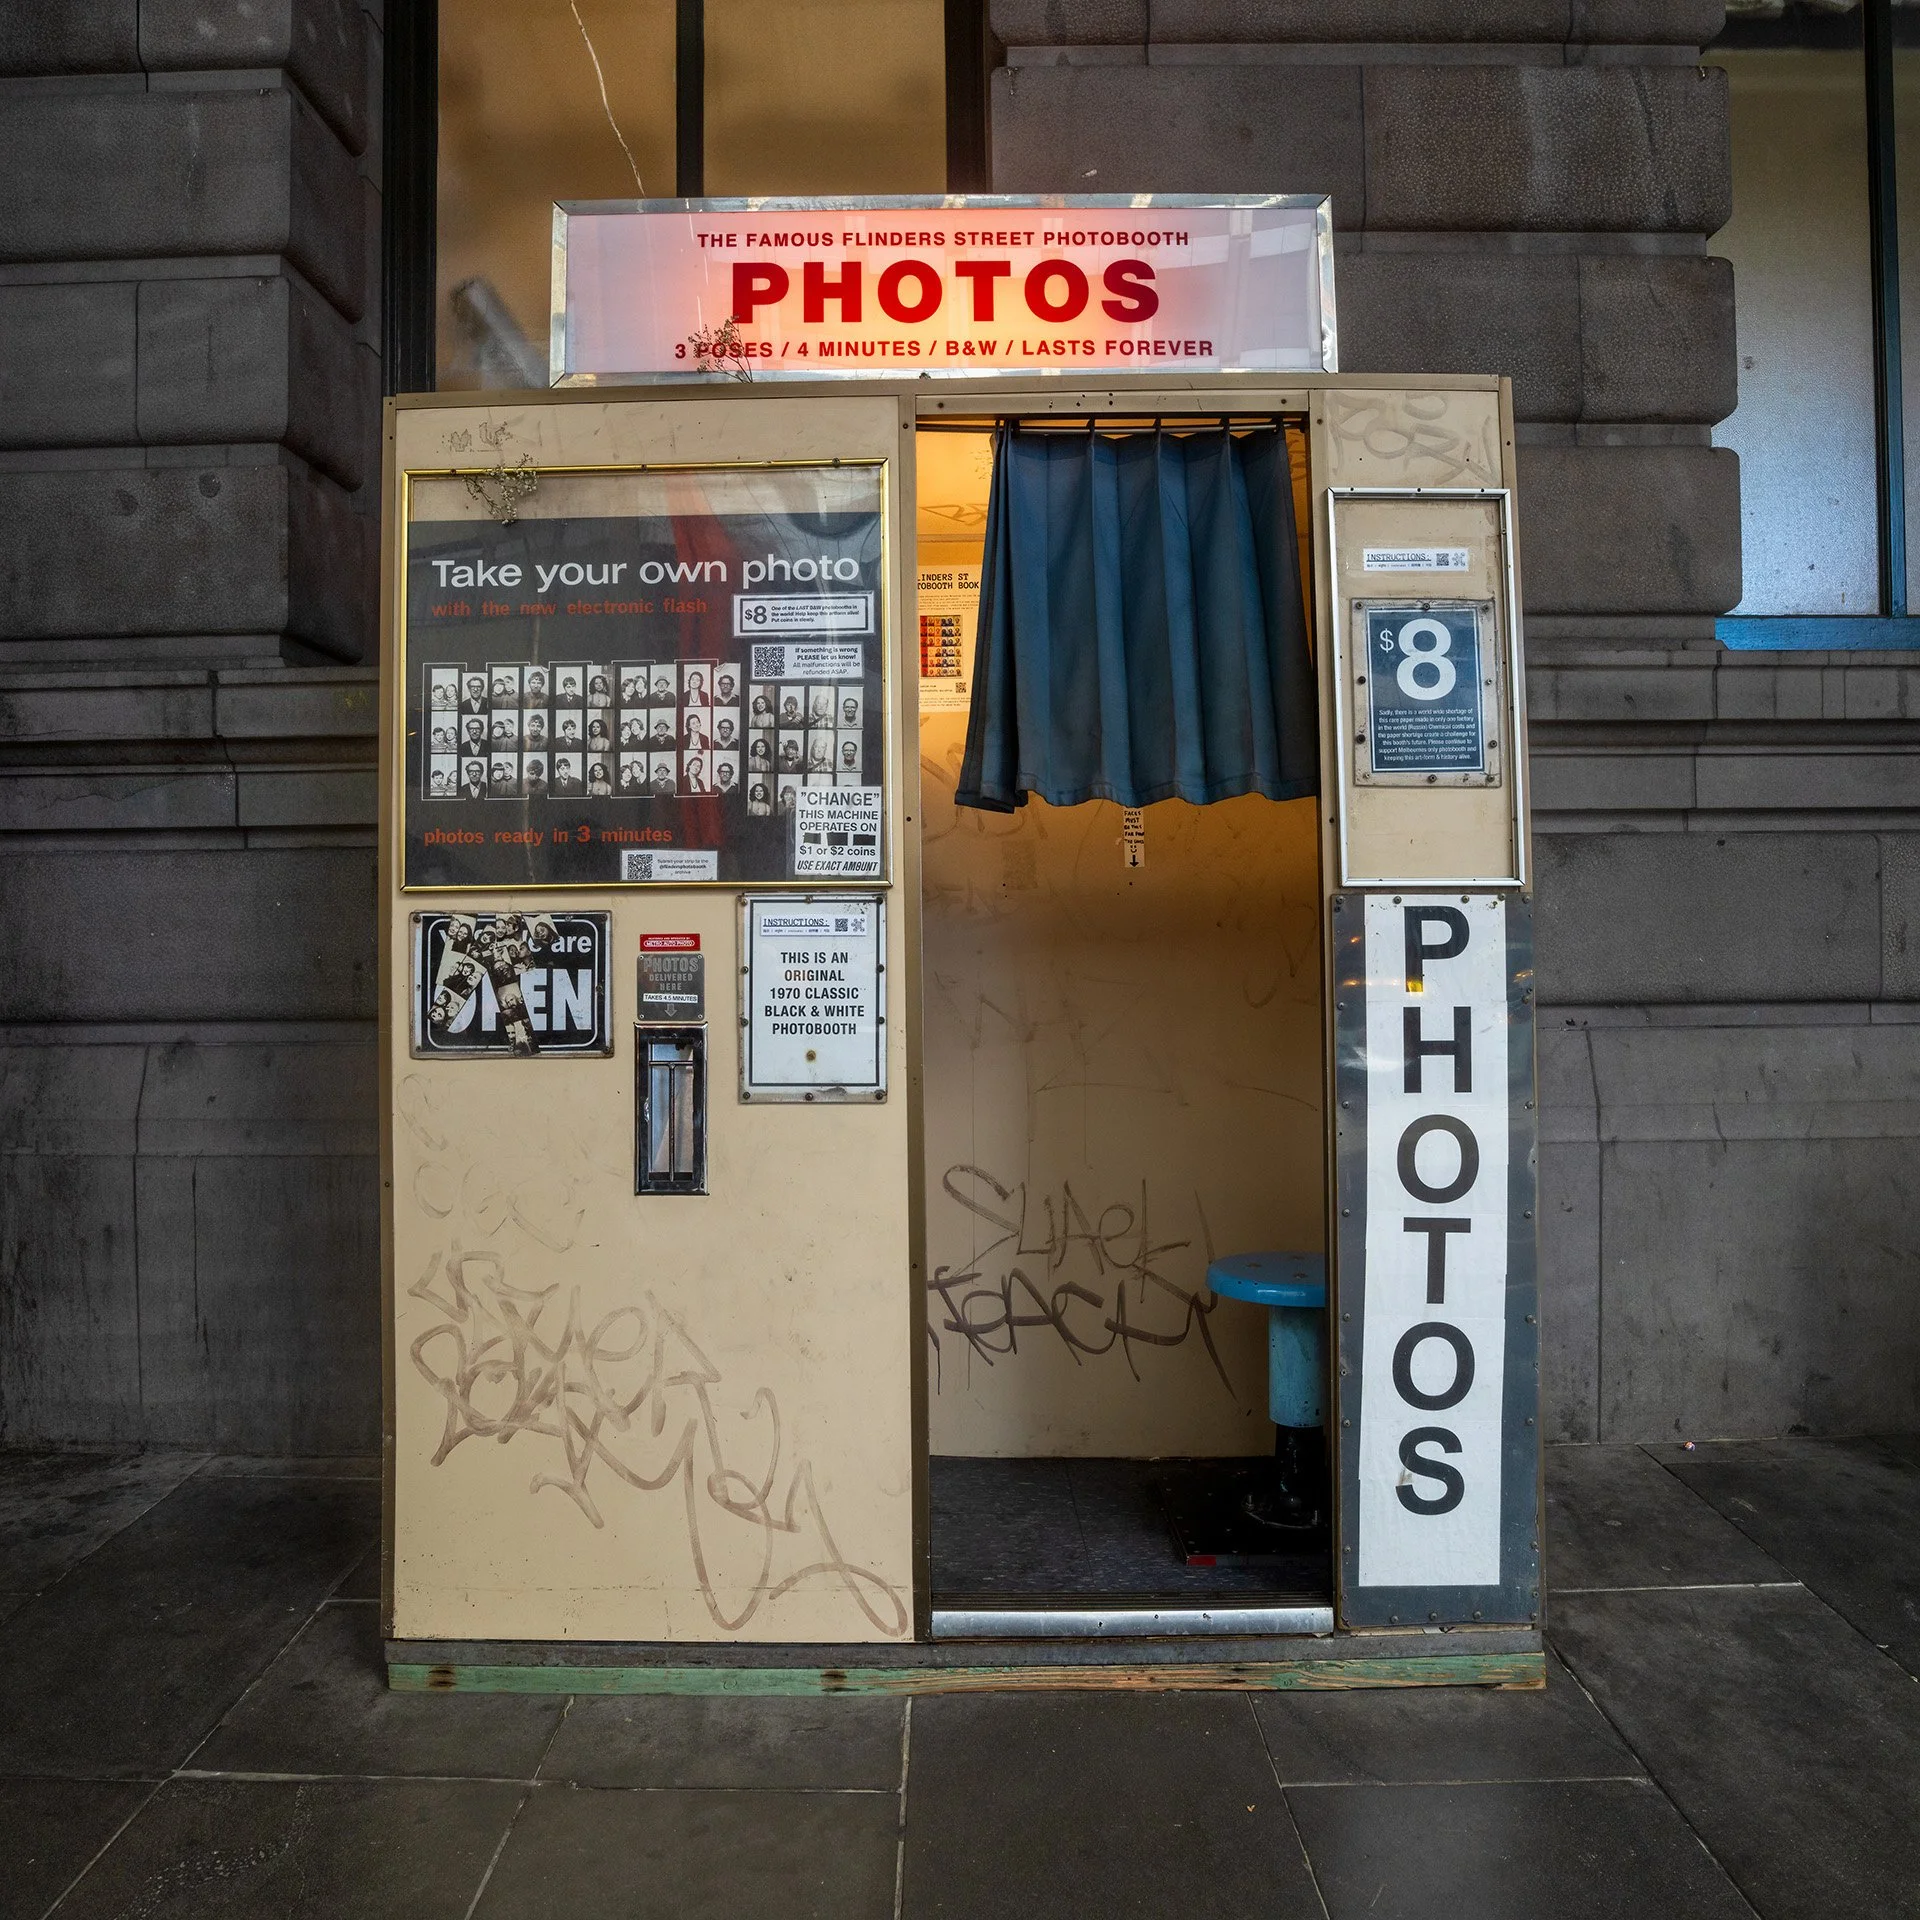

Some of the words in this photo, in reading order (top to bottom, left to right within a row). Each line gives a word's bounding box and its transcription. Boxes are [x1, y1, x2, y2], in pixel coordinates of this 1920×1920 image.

[698, 234, 738, 248] THE
[746, 232, 834, 247] FAMOUS
[842, 232, 946, 246] FLINDERS
[954, 232, 1034, 246] STREET
[1044, 232, 1189, 246] PHOTOBOOTH
[732, 259, 1160, 324] PHOTOS
[675, 344, 686, 358] 3
[697, 342, 773, 358] POSES
[798, 342, 809, 357] 4
[819, 340, 920, 356] MINUTES
[946, 340, 998, 356] B&W
[1022, 340, 1096, 356] LASTS
[1105, 340, 1213, 356] FOREVER
[1366, 553, 1430, 562] INSTRUCTIONS:
[432, 560, 522, 587] Take
[535, 562, 627, 592] your
[640, 561, 727, 584] own
[743, 554, 859, 589] photo
[432, 600, 471, 616] with
[482, 600, 510, 616] the
[520, 603, 556, 616] new
[567, 599, 654, 615] electronic
[664, 598, 707, 613] flash
[745, 606, 767, 624] $8
[1380, 618, 1456, 700] $8
[799, 810, 824, 819] THIS
[828, 810, 878, 820] MACHINE
[800, 822, 857, 831] OPERATES
[860, 823, 876, 832] ON
[424, 828, 484, 846] photos
[494, 828, 544, 846] ready
[553, 827, 568, 843] in
[576, 825, 591, 843] 3
[601, 827, 673, 843] minutes
[800, 846, 812, 855] $1
[830, 846, 844, 856] $2
[847, 847, 876, 856] coins
[797, 860, 814, 870] USE
[815, 861, 842, 870] EXACT
[842, 862, 878, 871] AMOUNT
[763, 918, 829, 927] INSTRUCTIONS:
[551, 936, 592, 953] are
[781, 952, 809, 963] THIS
[814, 952, 826, 963] IS
[831, 952, 848, 963] AN
[644, 957, 698, 972] PHOTOS
[785, 970, 844, 981] ORIGINAL
[770, 988, 800, 999] 1970
[805, 988, 859, 999] CLASSIC
[764, 1005, 806, 1017] BLACK
[810, 1005, 820, 1017] &
[824, 1005, 864, 1017] WHITE
[772, 1023, 856, 1034] PHOTOBOOTH
[1391, 905, 1480, 1516] PHOTOS
